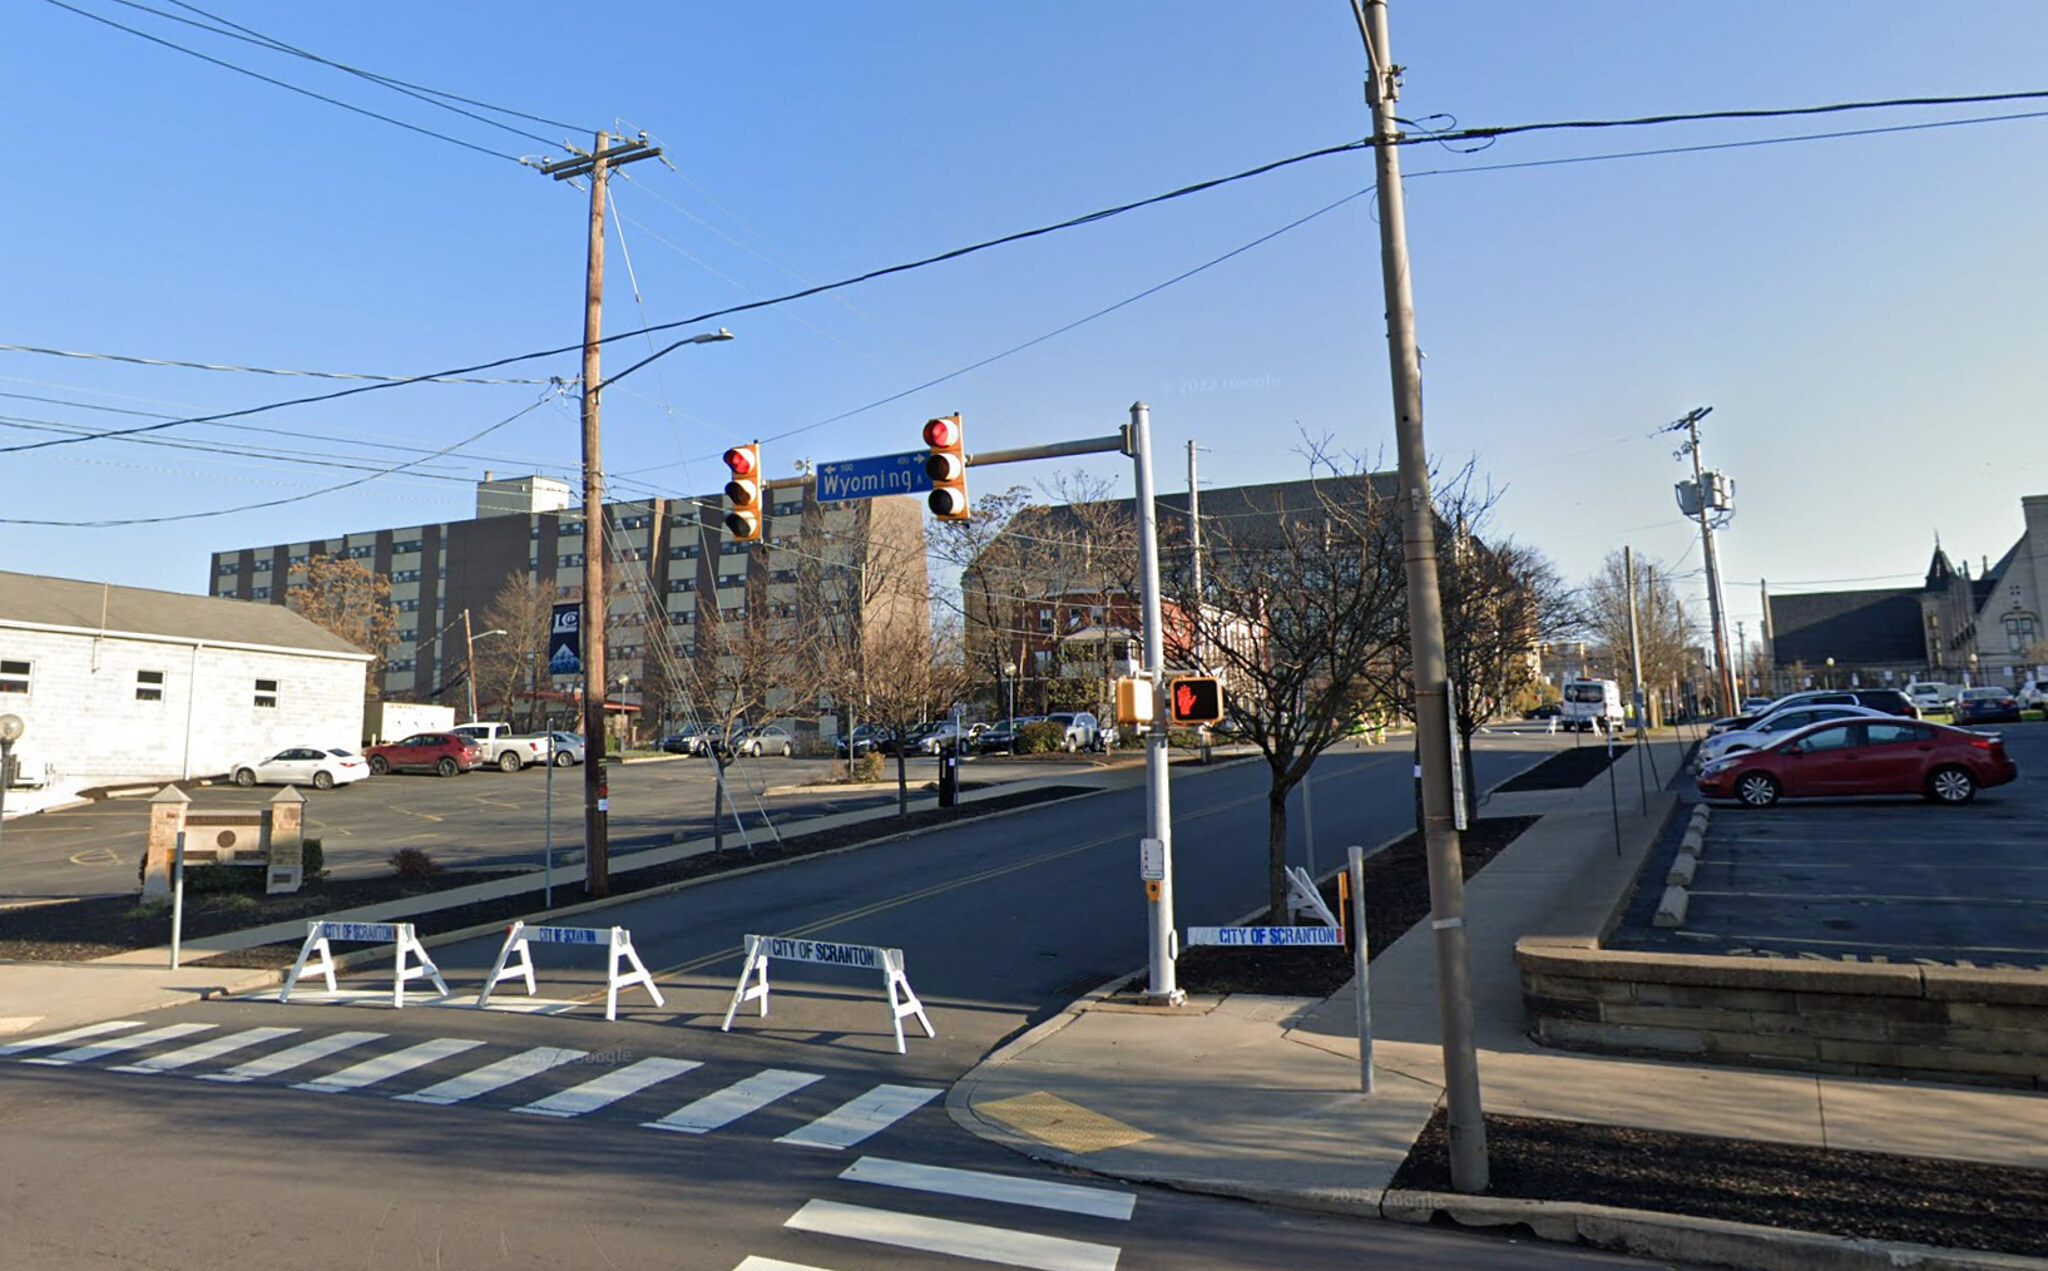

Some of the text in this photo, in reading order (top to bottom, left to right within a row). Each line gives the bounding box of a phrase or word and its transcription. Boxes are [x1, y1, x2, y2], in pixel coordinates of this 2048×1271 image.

[840, 463, 853, 473] 500
[823, 469, 912, 496] Wyoming
[323, 923, 393, 940] CITY OF SCRANTON
[1219, 928, 1335, 944] CITY OF SCRANTON
[772, 939, 876, 966] CITY OF SCRANTON
